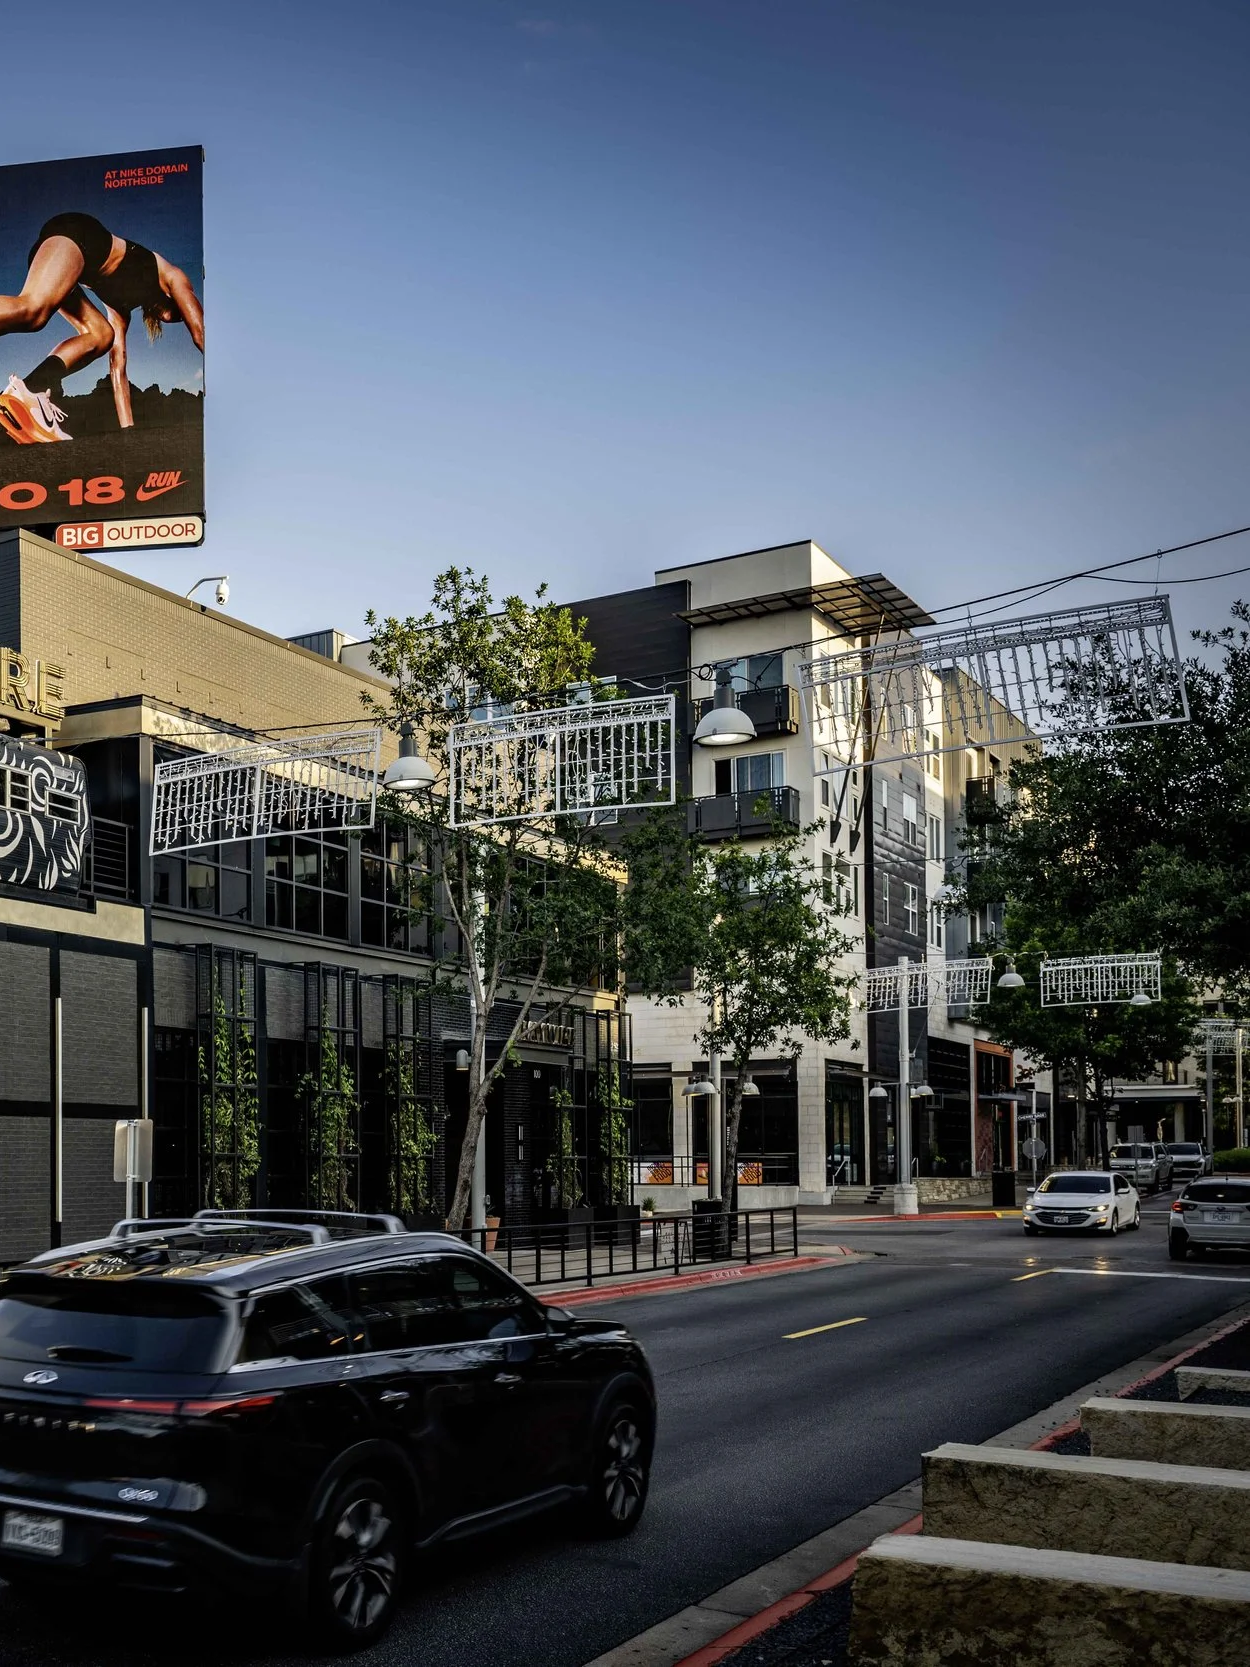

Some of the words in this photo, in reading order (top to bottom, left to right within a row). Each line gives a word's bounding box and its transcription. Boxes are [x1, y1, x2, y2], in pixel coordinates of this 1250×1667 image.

[104, 170, 118, 180] AT
[119, 167, 144, 178] NIKE
[146, 163, 189, 176] DOMAIN
[104, 175, 165, 189] NORTHSIDE
[145, 471, 182, 488] RUN
[58, 476, 126, 506] 18
[62, 526, 99, 547] BIG
[107, 522, 196, 541] OUTDOOR
